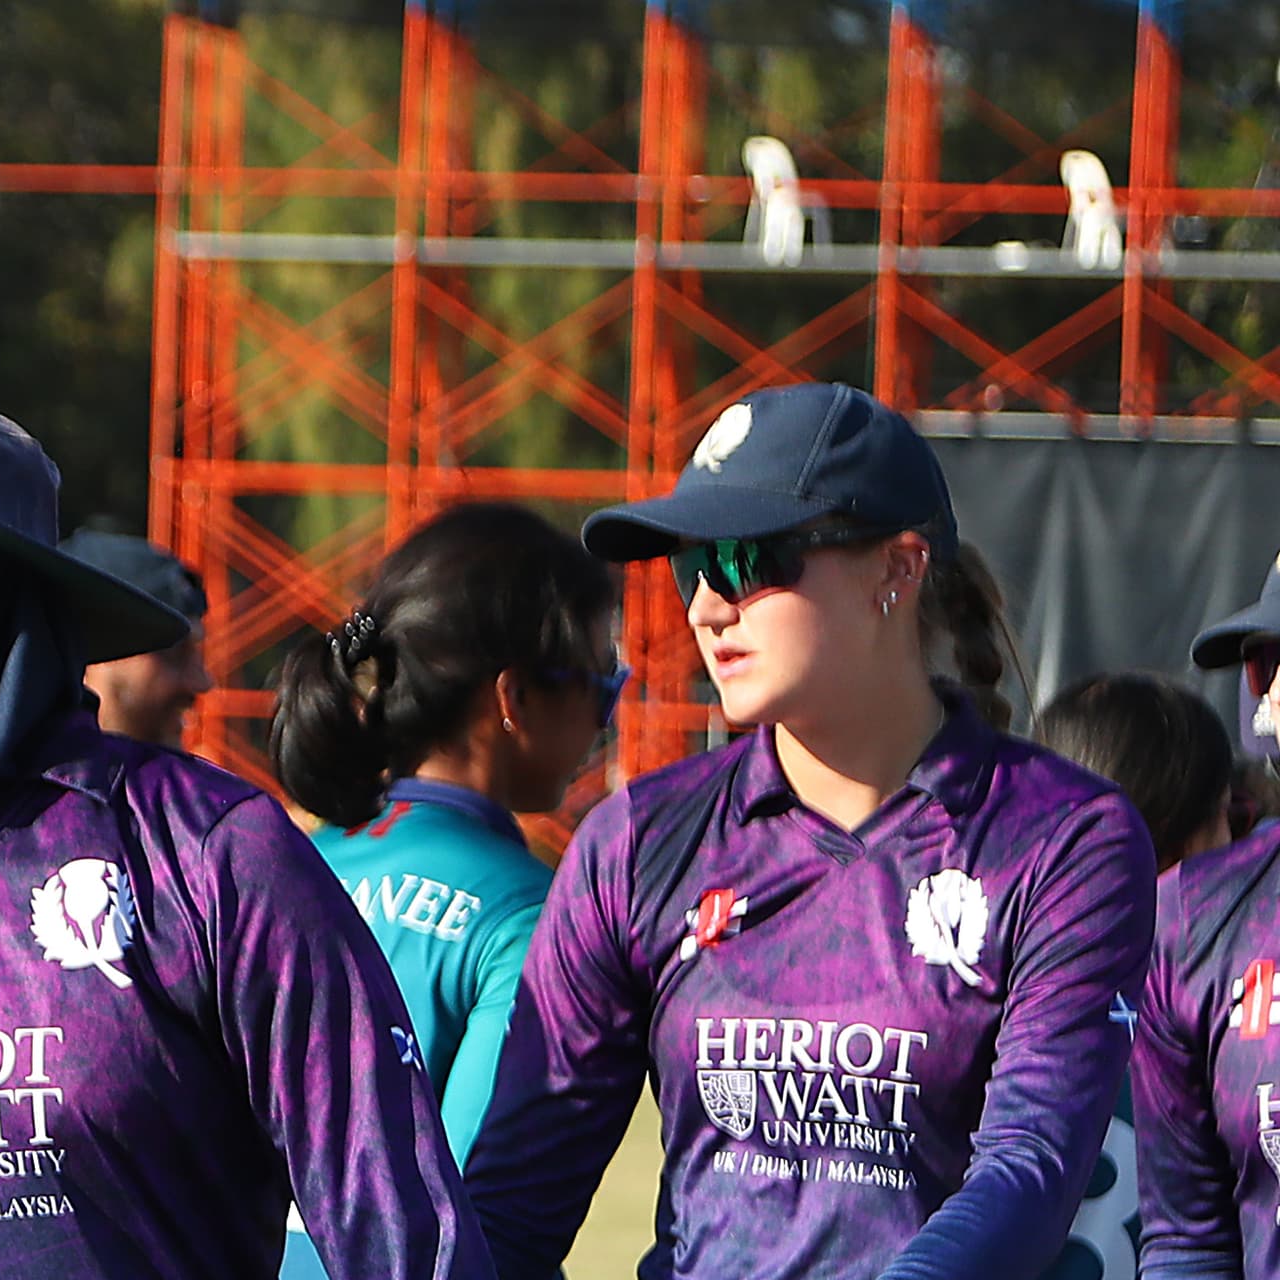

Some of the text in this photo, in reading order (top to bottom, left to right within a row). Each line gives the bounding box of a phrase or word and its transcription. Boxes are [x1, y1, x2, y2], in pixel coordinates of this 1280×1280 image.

[695, 1017, 928, 1081] HERIOT
[758, 1070, 921, 1131] WATT
[761, 1120, 917, 1157] UNIVERSITY
[713, 1151, 918, 1191] UK DUBAI MALAYSIA
